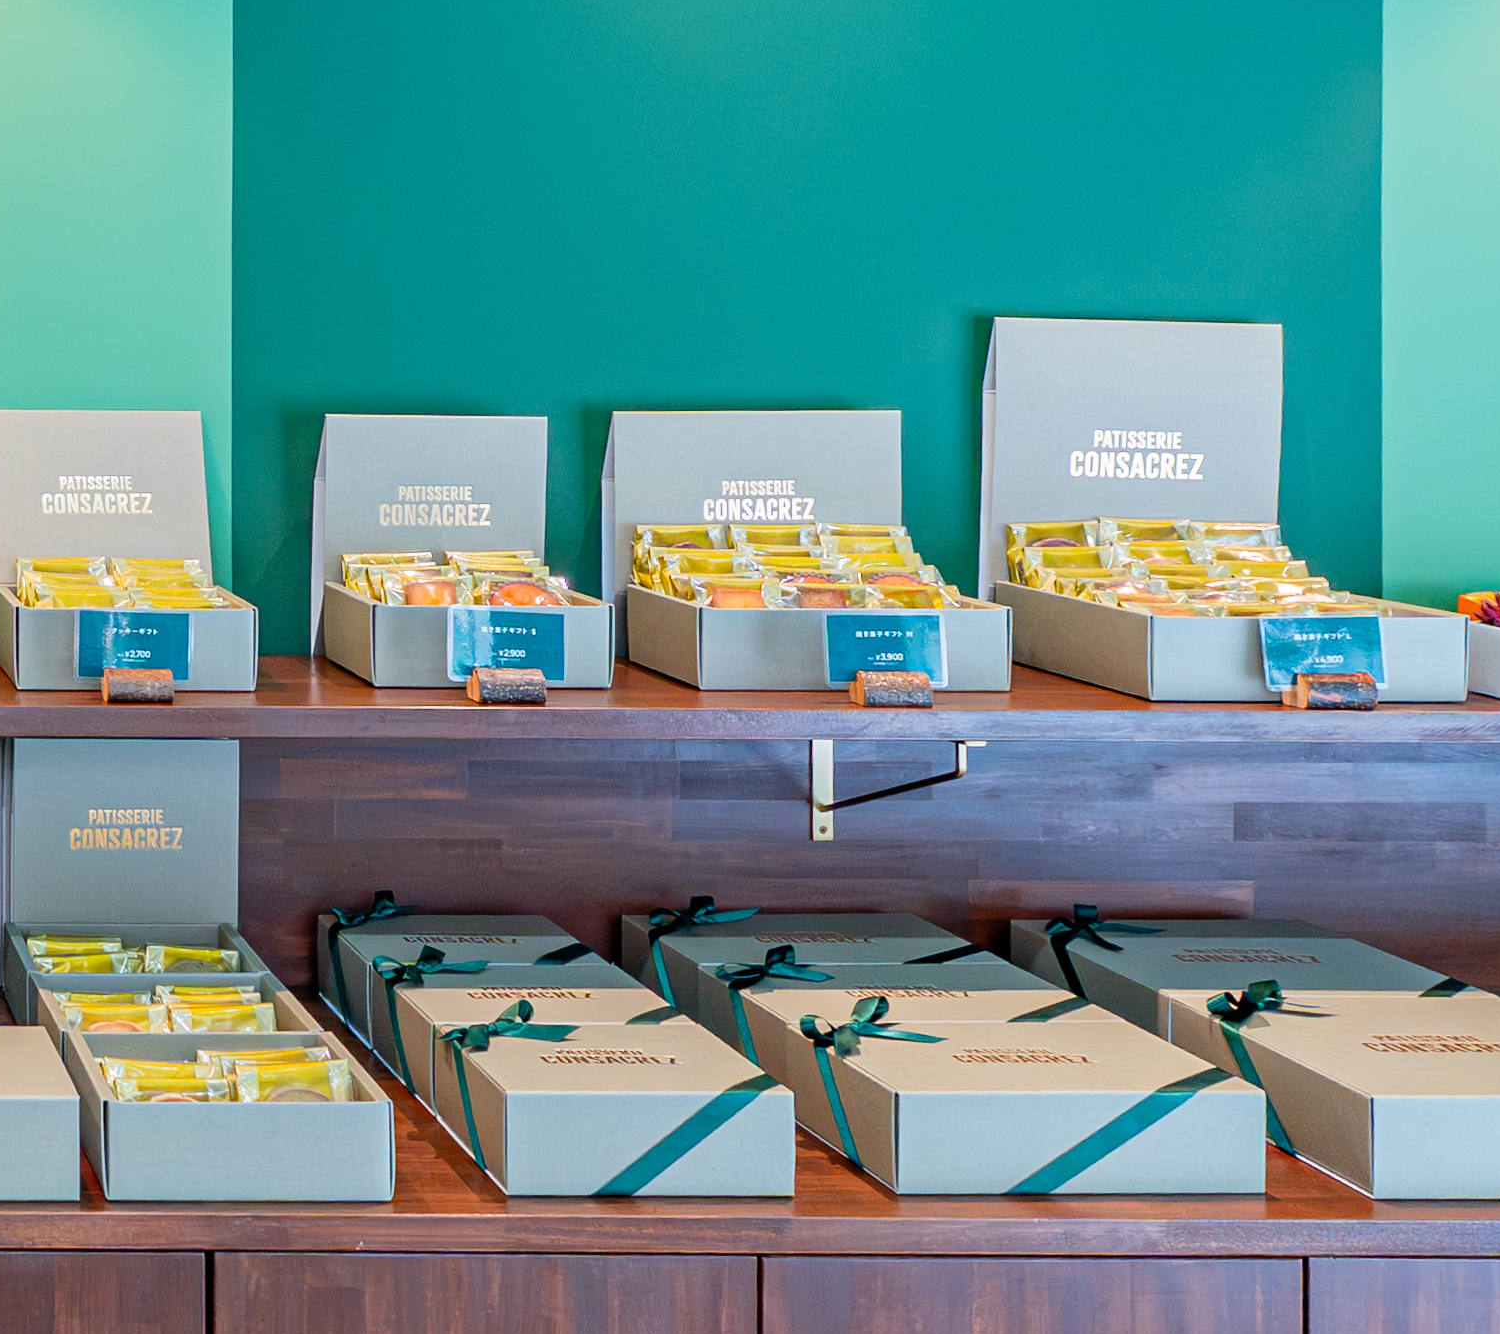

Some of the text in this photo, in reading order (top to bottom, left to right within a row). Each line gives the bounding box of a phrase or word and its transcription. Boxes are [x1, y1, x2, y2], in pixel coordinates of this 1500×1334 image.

[1093, 429, 1183, 450] PATISSERIE
[1069, 450, 1204, 480] CONSACREZ
[58, 474, 133, 492] PATISSERIE
[721, 479, 796, 497] PATISSERIE
[398, 485, 473, 503] PATISSERIE
[41, 492, 153, 515] CONSACREZ
[702, 497, 815, 520] CONSACREZ
[378, 503, 491, 527] CONSACREZ
[125, 650, 151, 659] ¥2,700
[88, 807, 164, 824] PATISSERIE
[69, 826, 183, 851] CONSACREZ
[1171, 953, 1322, 964] CONSACREZ
[539, 1055, 677, 1065] CONSACREZ
[951, 1054, 1097, 1064] CONSACREZ
